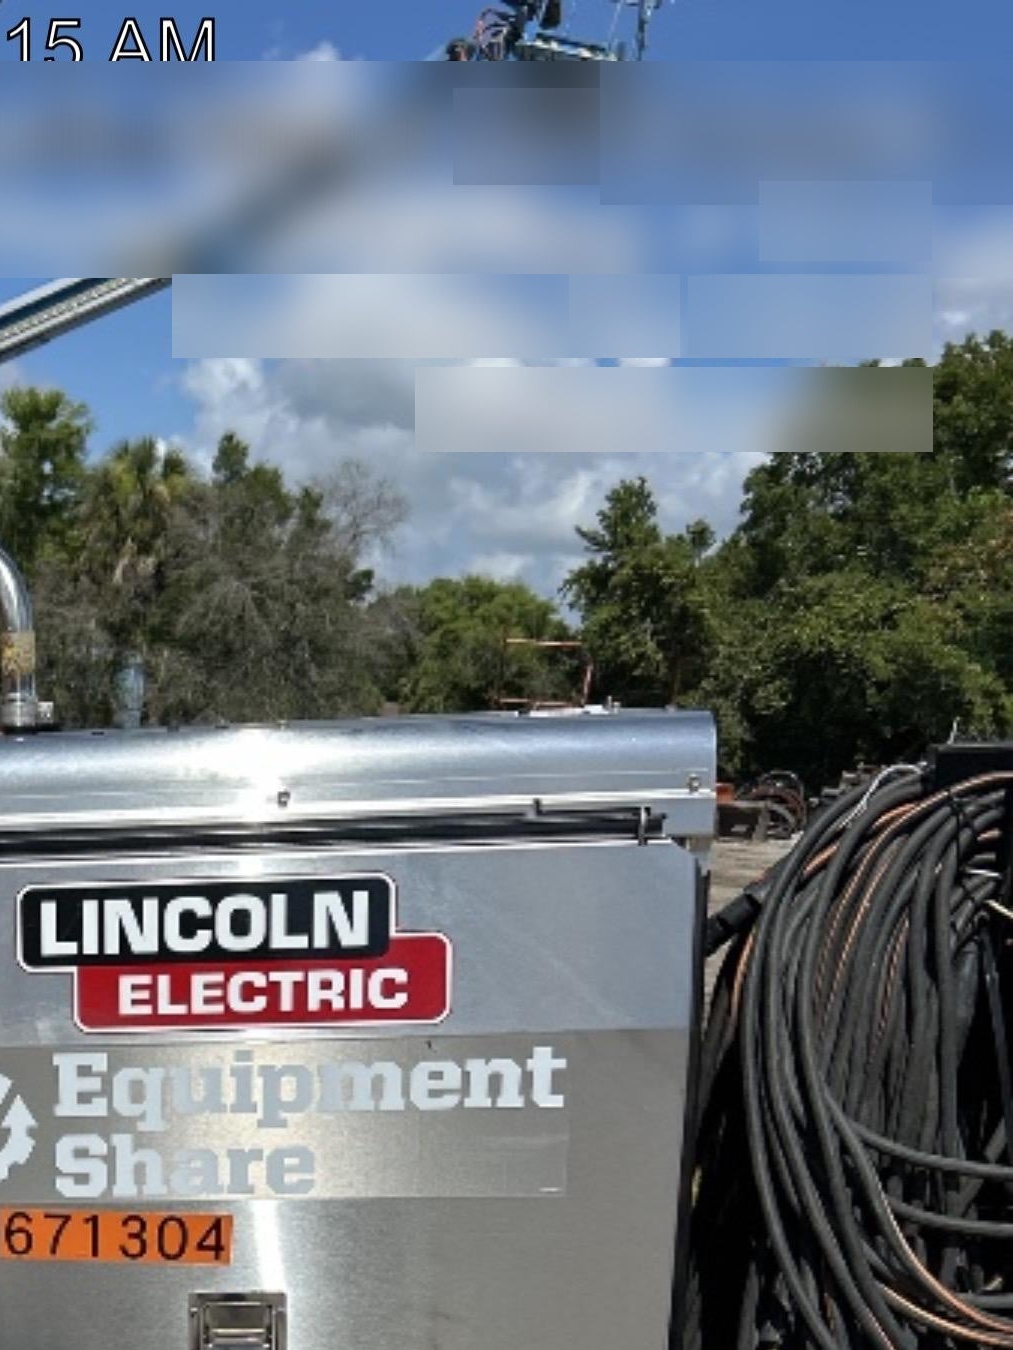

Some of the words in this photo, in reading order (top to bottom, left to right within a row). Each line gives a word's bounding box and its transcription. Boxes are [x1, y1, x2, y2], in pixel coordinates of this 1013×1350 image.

[39, 890, 370, 958] LINCOLN
[117, 966, 409, 1016] ELECTRIC
[52, 1045, 568, 1133] Equipment
[53, 1133, 316, 1198] Share
[3, 1210, 228, 1262] 671304
